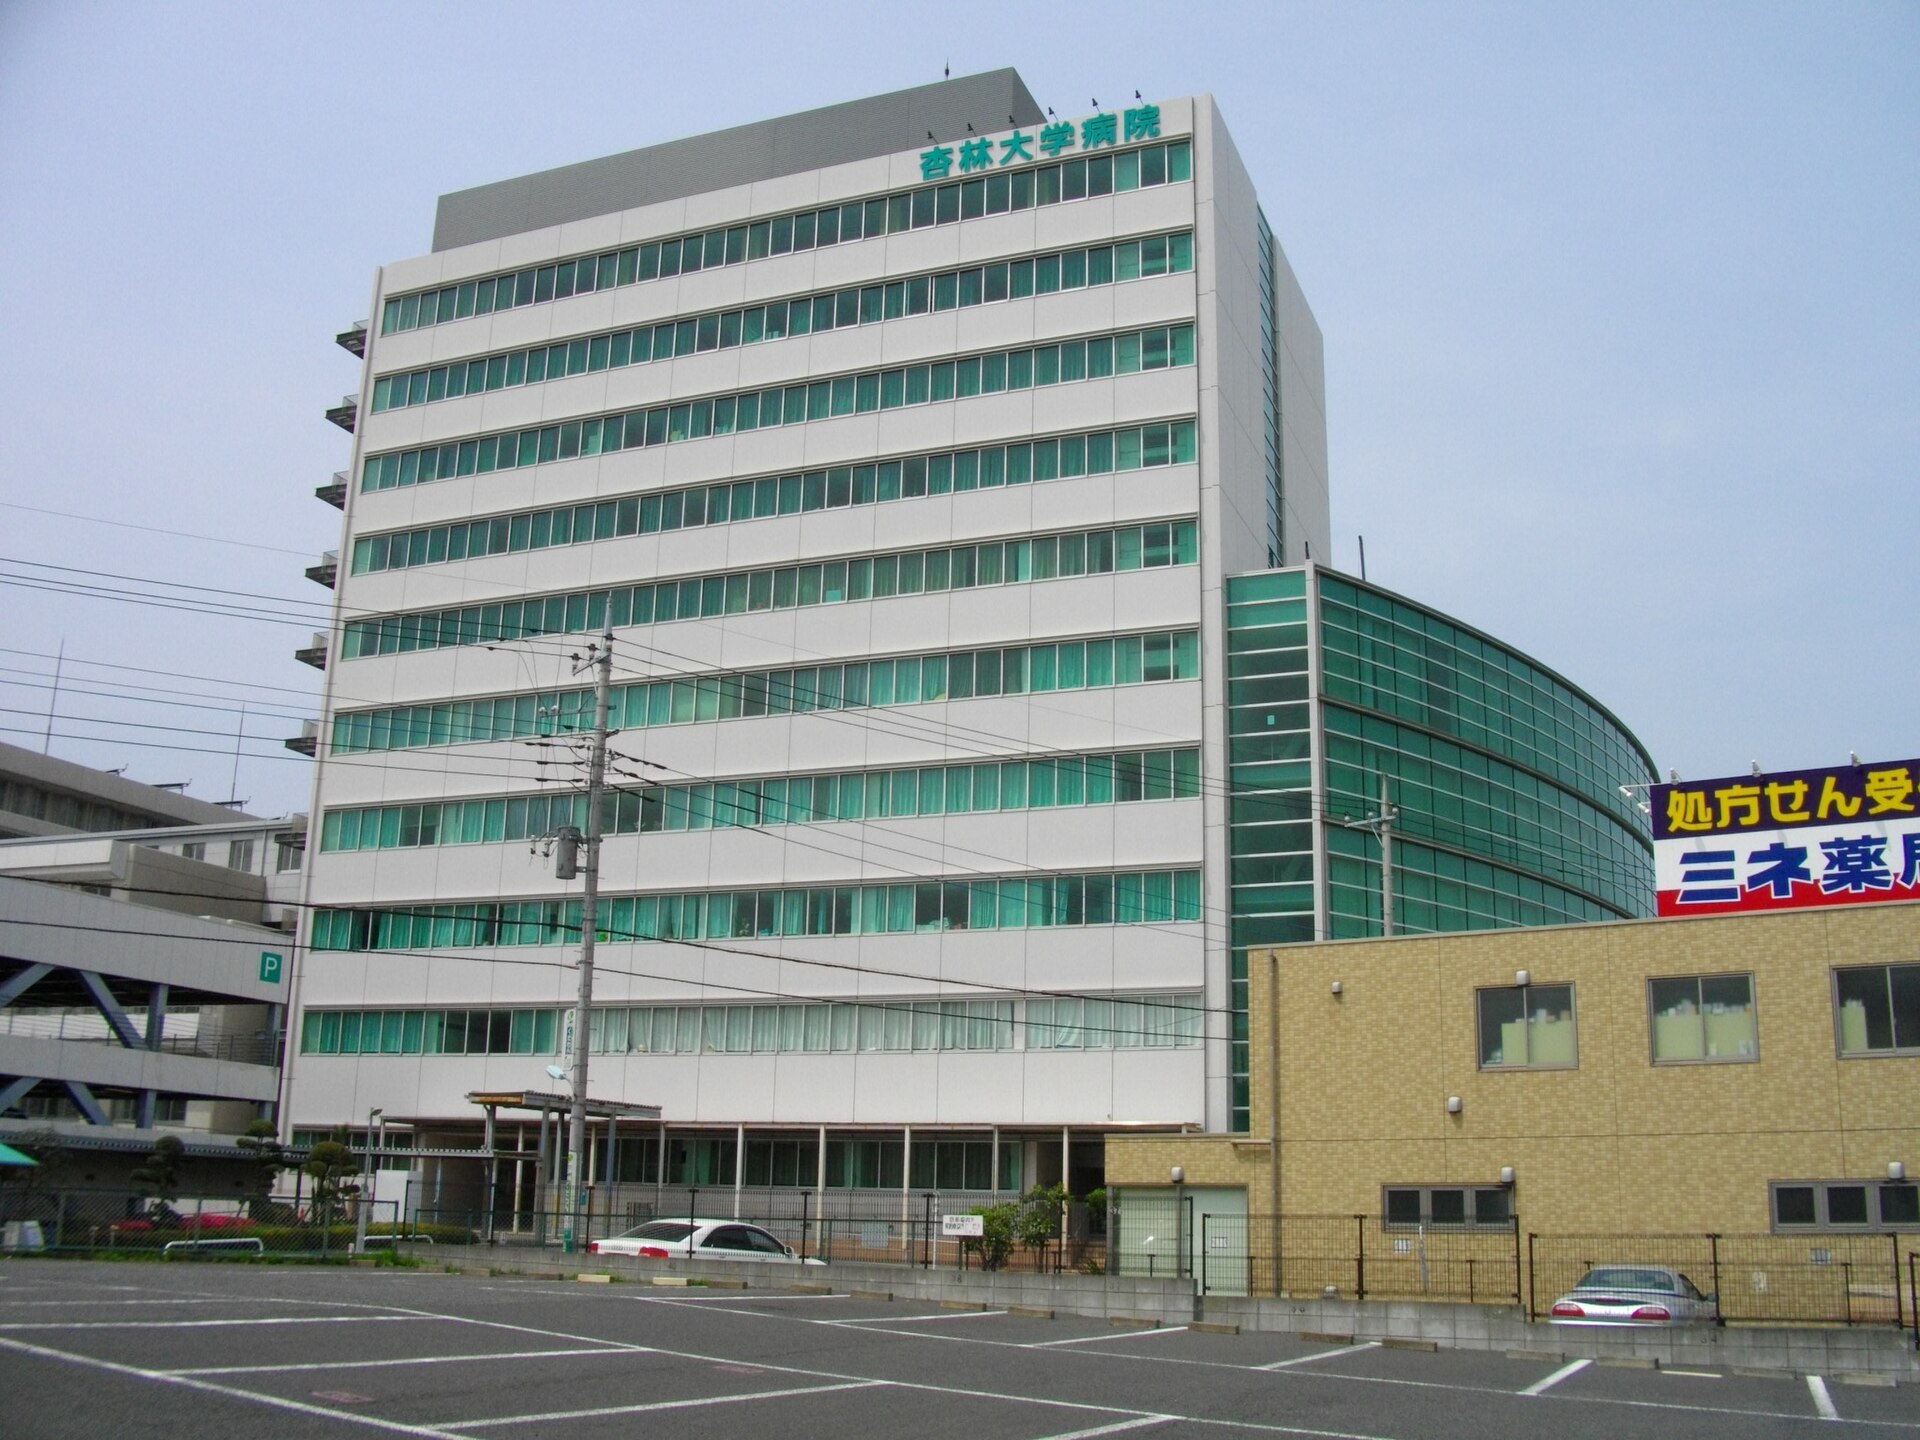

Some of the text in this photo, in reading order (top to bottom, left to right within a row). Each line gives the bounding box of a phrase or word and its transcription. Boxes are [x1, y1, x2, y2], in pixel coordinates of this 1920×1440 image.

[920, 104, 1161, 181] 杏林大学病院
[1667, 767, 1920, 833] 処方せん受
[264, 956, 278, 978] P
